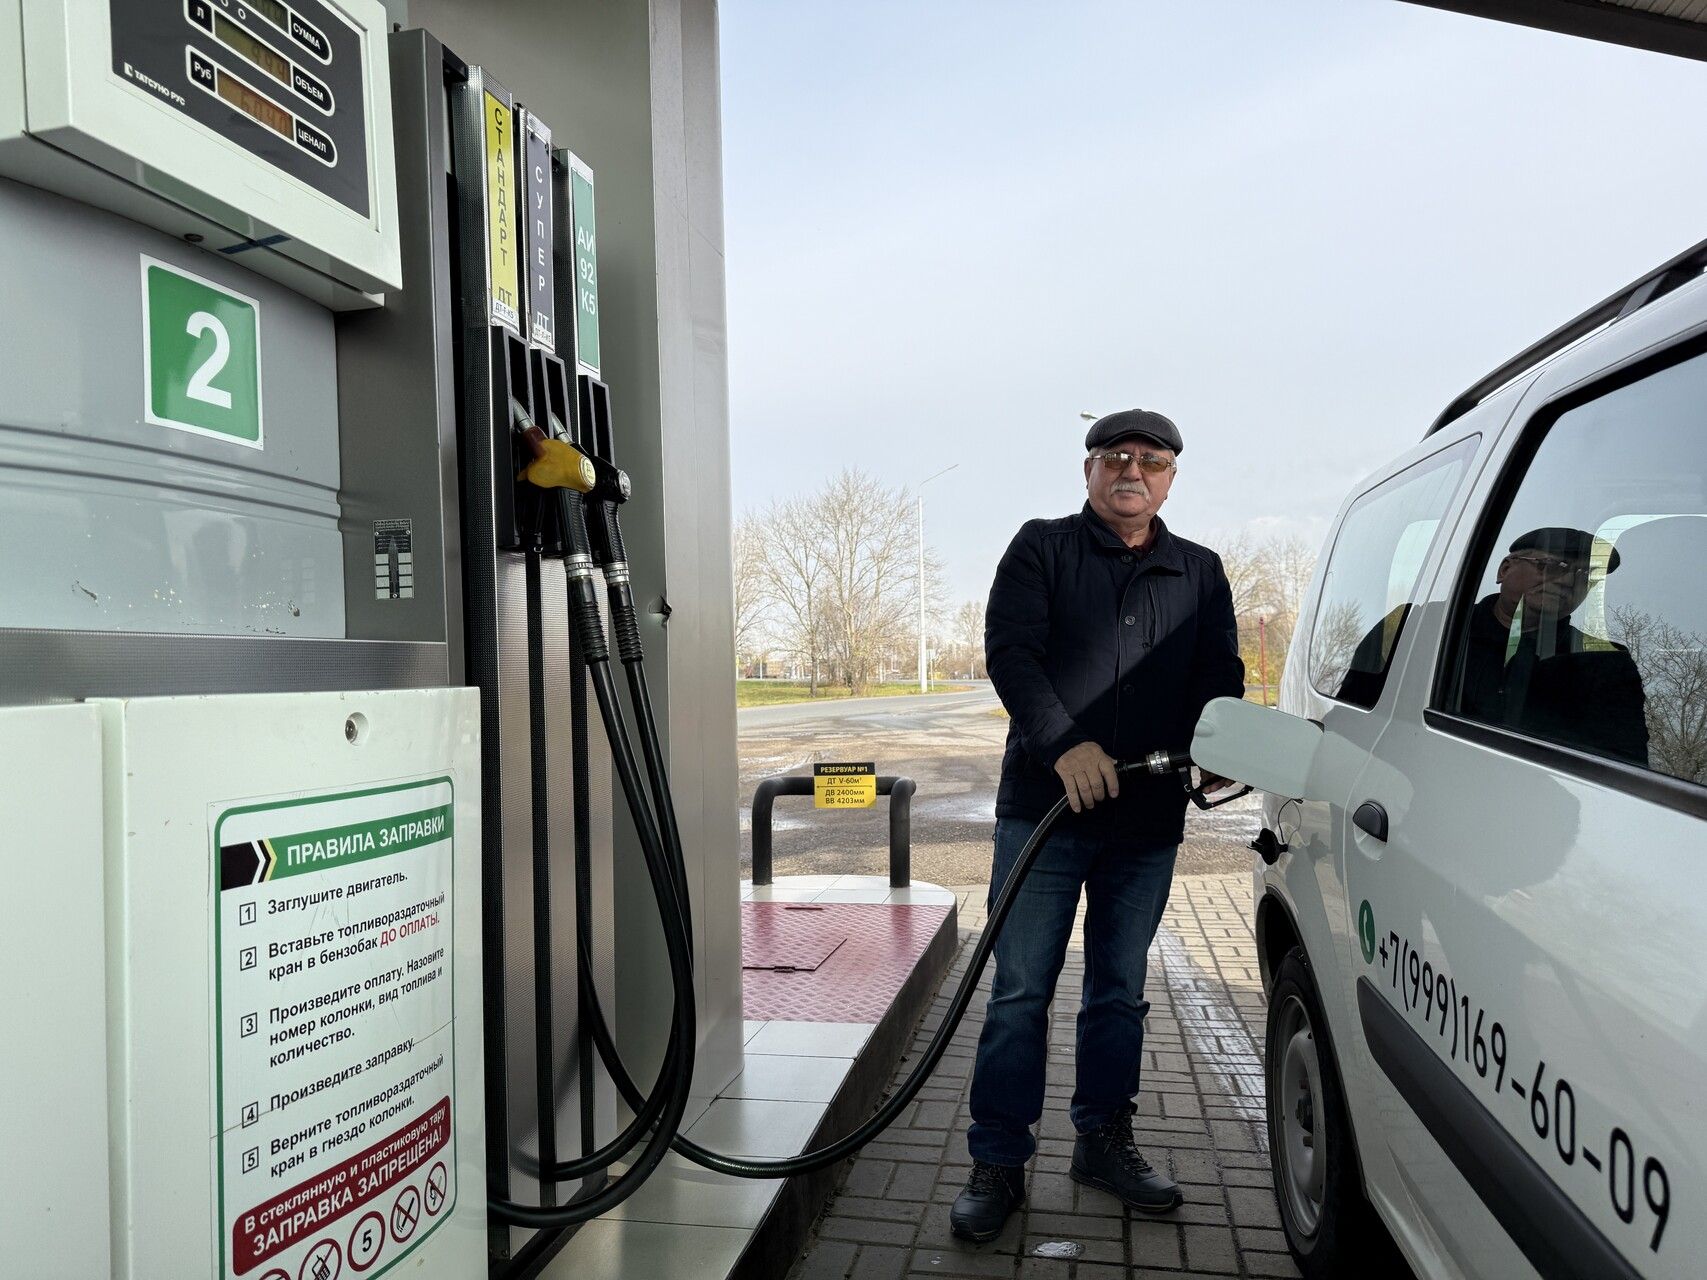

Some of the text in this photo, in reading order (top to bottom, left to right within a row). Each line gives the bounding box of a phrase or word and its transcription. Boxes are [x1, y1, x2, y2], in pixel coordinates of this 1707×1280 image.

[293, 22, 321, 50] СУММА
[194, 61, 212, 80] Руб
[295, 75, 324, 102] ОБЪЕМ
[170, 91, 186, 106] РУС
[298, 127, 327, 153] ЦЕНА/Л
[494, 107, 508, 267] СТАНДАРТ
[535, 165, 546, 292] СУПЕР
[578, 226, 595, 257] АИ
[497, 285, 512, 308] ДТ
[580, 260, 595, 286] 92
[536, 311, 550, 330] ДТ
[581, 287, 596, 316] К5
[186, 311, 232, 409] 2
[287, 815, 445, 866] ПРАВИЛА ЗАПРАВКИ
[245, 872, 408, 921] 1 Заглушите двигатель.
[244, 891, 445, 967] 2 Вставьте топливораздаточный
[269, 912, 440, 981] кран в бензобак ДО ОПЛАТЫ.
[245, 947, 444, 1032] 3 Произведите оплату. Назовите
[270, 966, 443, 1046] номер колонки, вид топлива и
[270, 1027, 355, 1068] количество.
[247, 1037, 416, 1121] 4 Произведите заправку.
[1379, 930, 1671, 1254] +7(999)169-60-09
[247, 1053, 444, 1167] 5 Верните топливораздаточный
[271, 1095, 415, 1178] кран в гнездо колонки.
[245, 1105, 446, 1234] В стеклянную и пластиковую тару
[253, 1126, 442, 1256] ЗАПРАВКА ЗАПРЕЩЕНА!
[362, 1229, 373, 1253] 5
